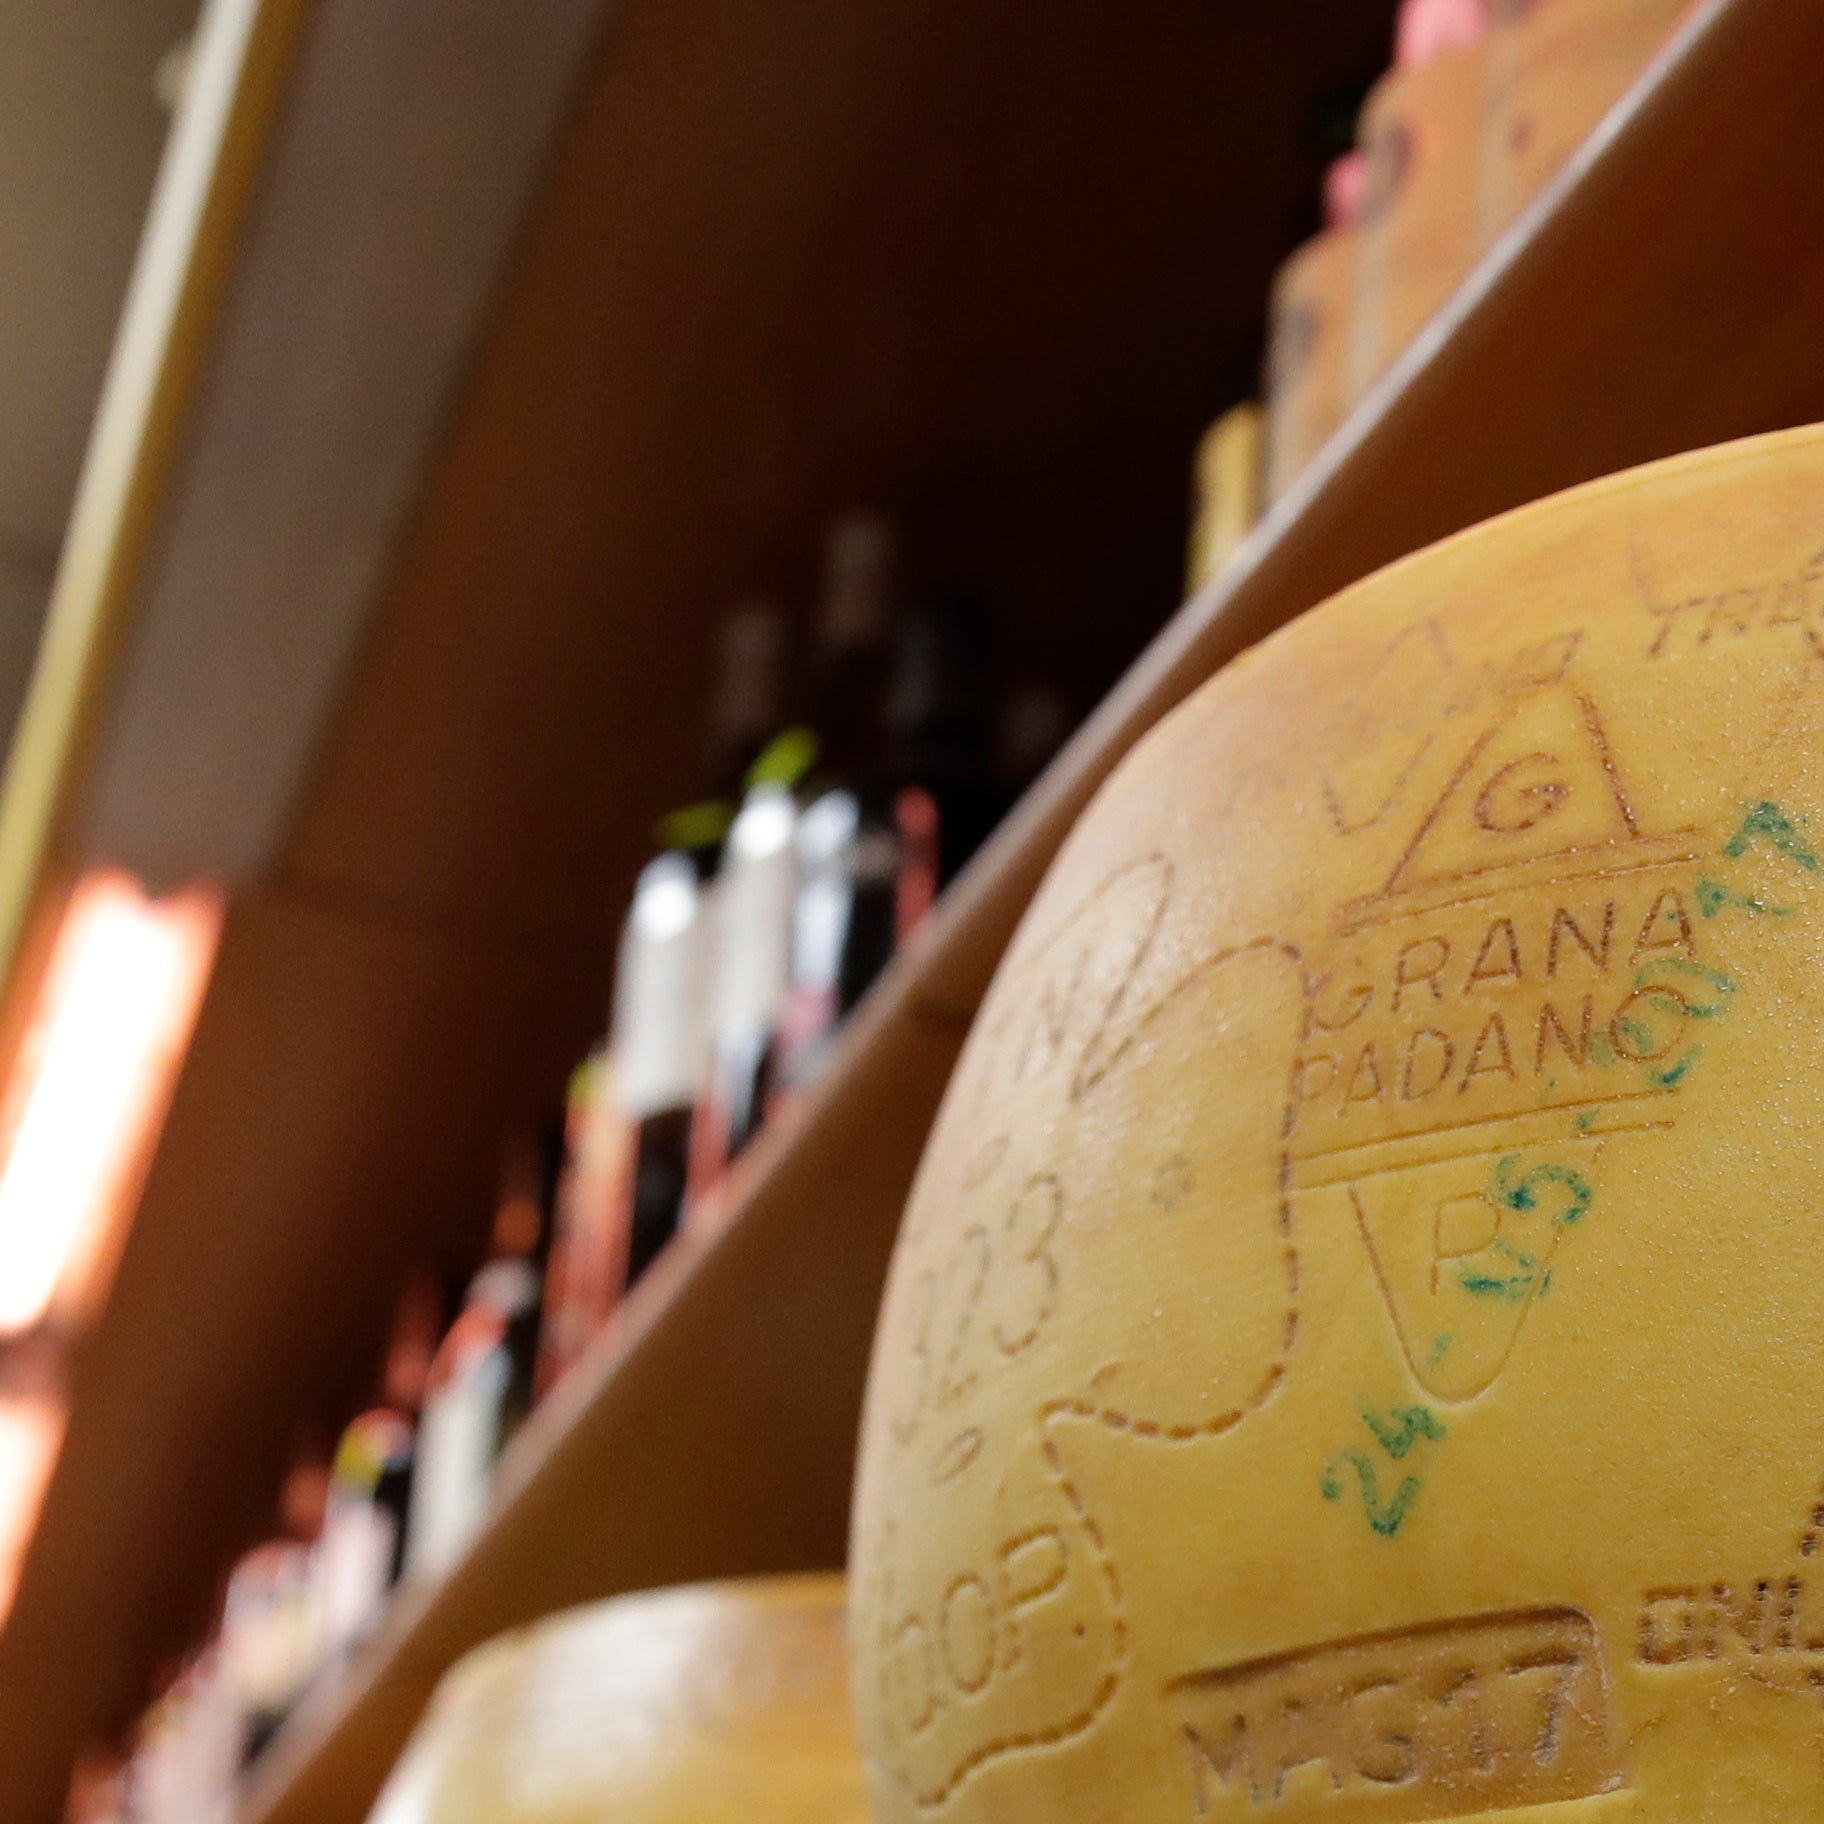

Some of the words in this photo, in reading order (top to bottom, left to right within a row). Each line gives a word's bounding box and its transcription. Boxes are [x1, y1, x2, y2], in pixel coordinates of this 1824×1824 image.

[1475, 750, 1572, 834] G
[1310, 887, 1697, 1032] GRANA
[1289, 984, 1690, 1118] PADANO
